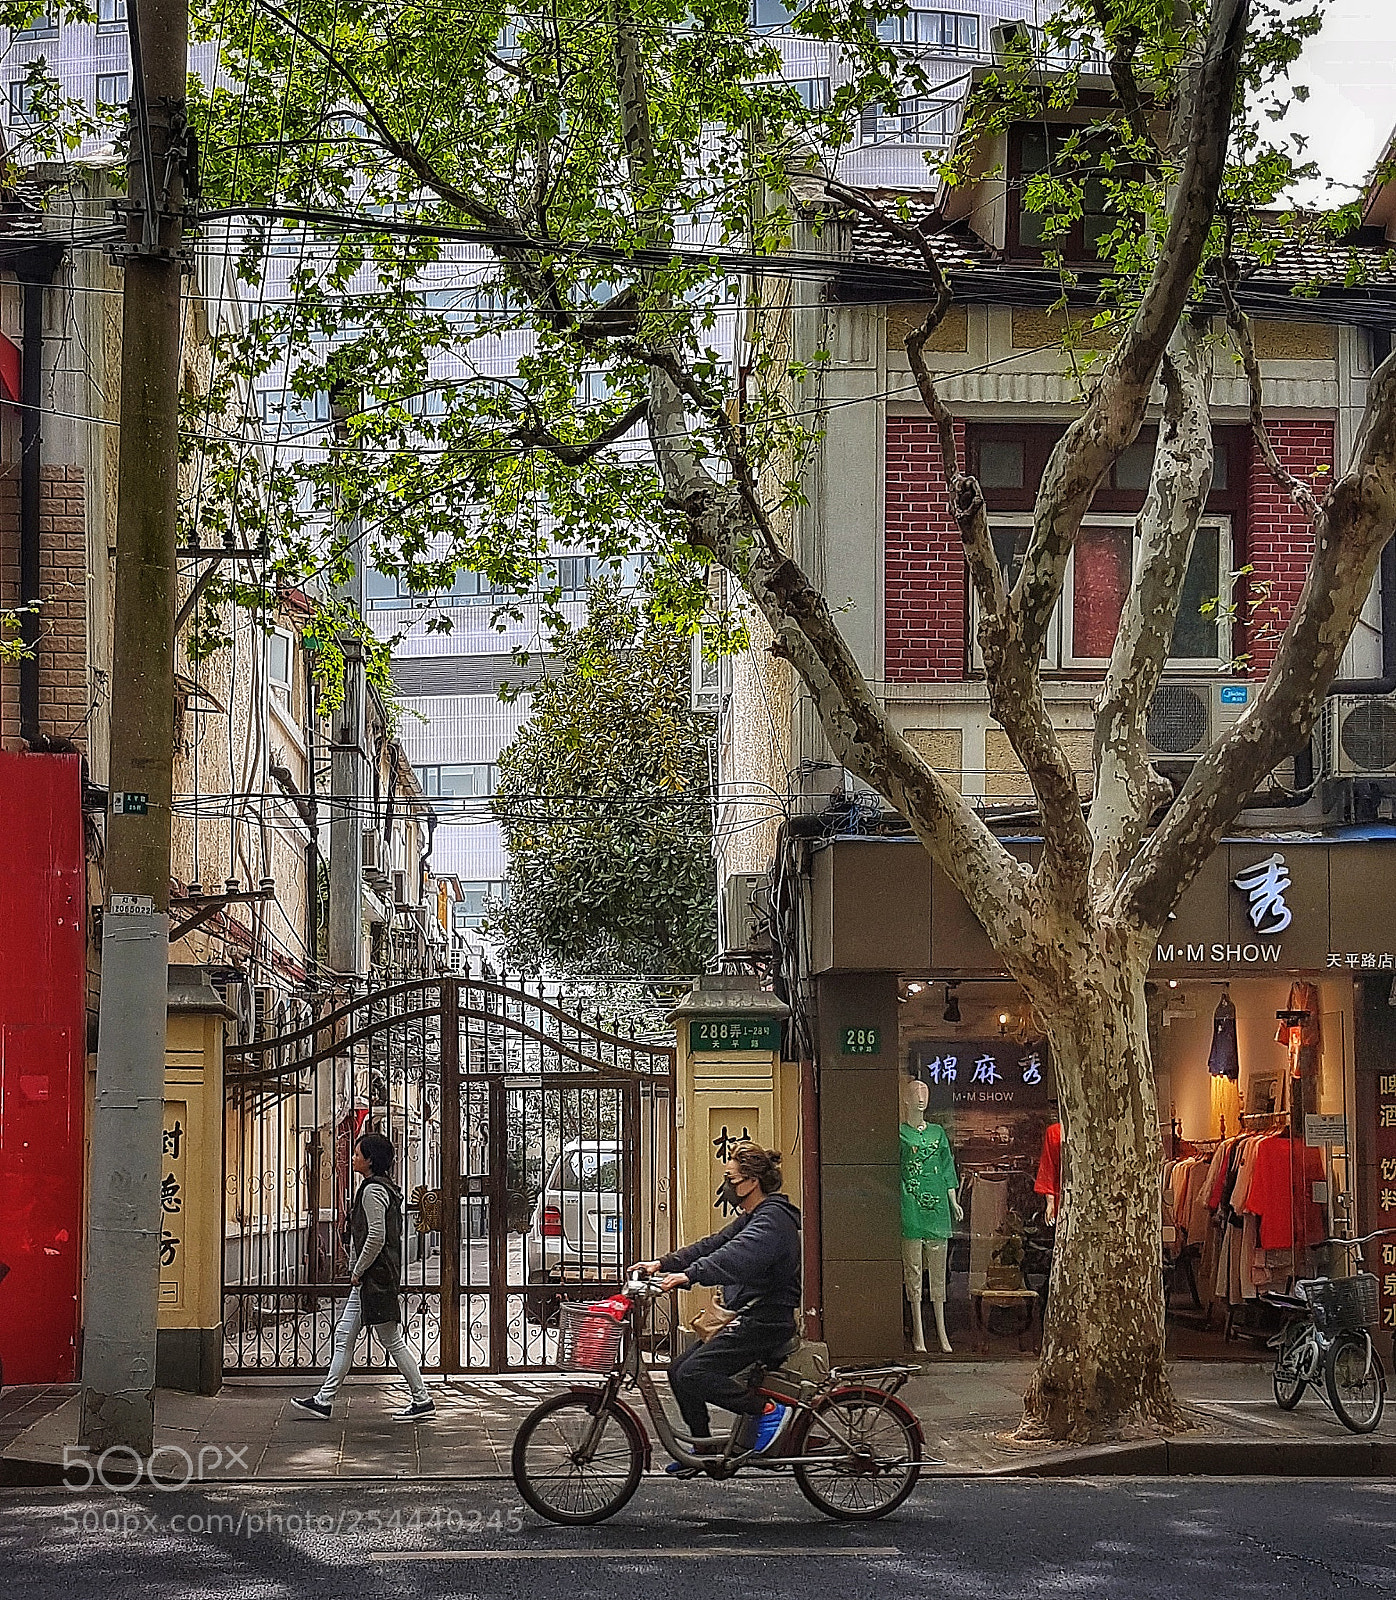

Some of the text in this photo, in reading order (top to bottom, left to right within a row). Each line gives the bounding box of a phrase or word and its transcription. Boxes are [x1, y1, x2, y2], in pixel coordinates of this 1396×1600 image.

[1234, 852, 1293, 934] 秀
[1210, 944, 1282, 962] SHOW
[1326, 952, 1396, 969] 天平路店
[847, 1030, 875, 1045] 286
[926, 1053, 1042, 1086] 棉麻秀
[979, 1092, 1014, 1102] SHOW
